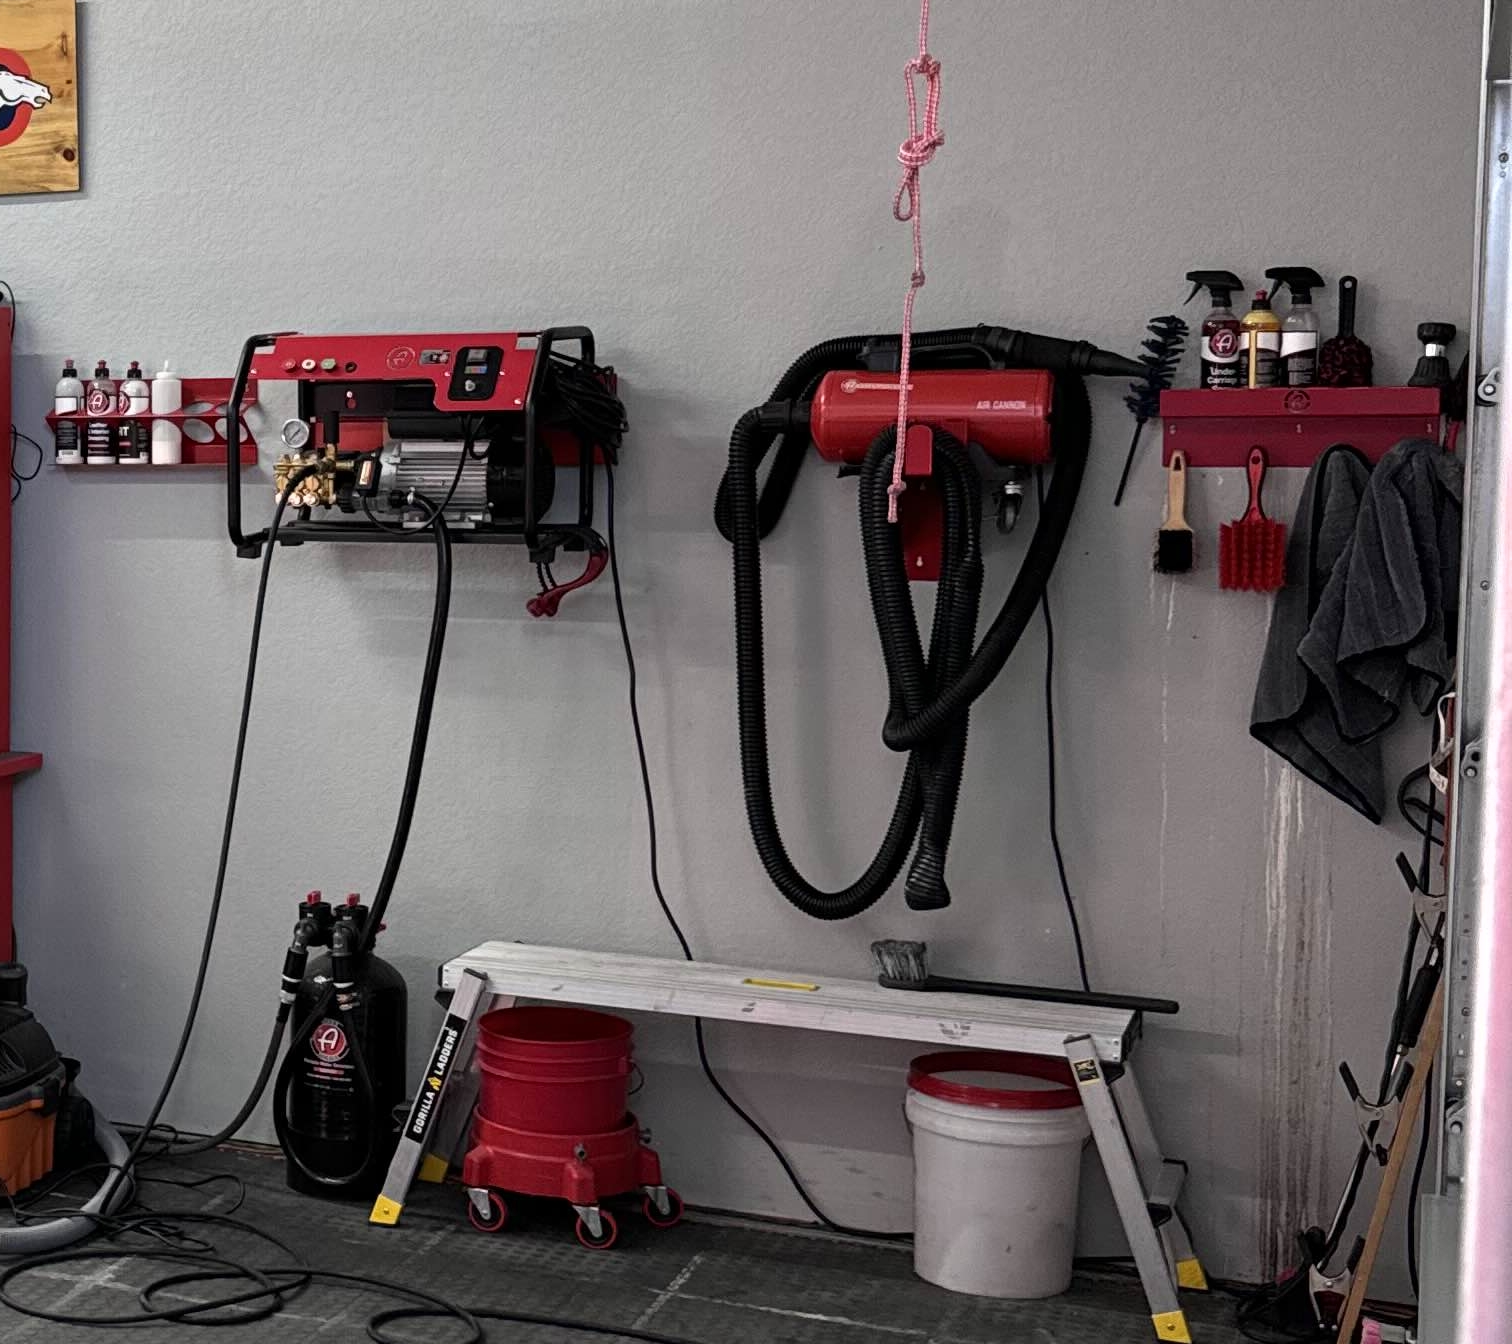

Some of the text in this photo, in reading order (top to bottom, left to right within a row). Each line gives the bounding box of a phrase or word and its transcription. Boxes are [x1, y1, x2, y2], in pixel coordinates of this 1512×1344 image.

[976, 400, 1027, 410] AIR CANNON
[434, 1030, 458, 1076] LADDERS
[413, 1091, 436, 1134] GORILLA
